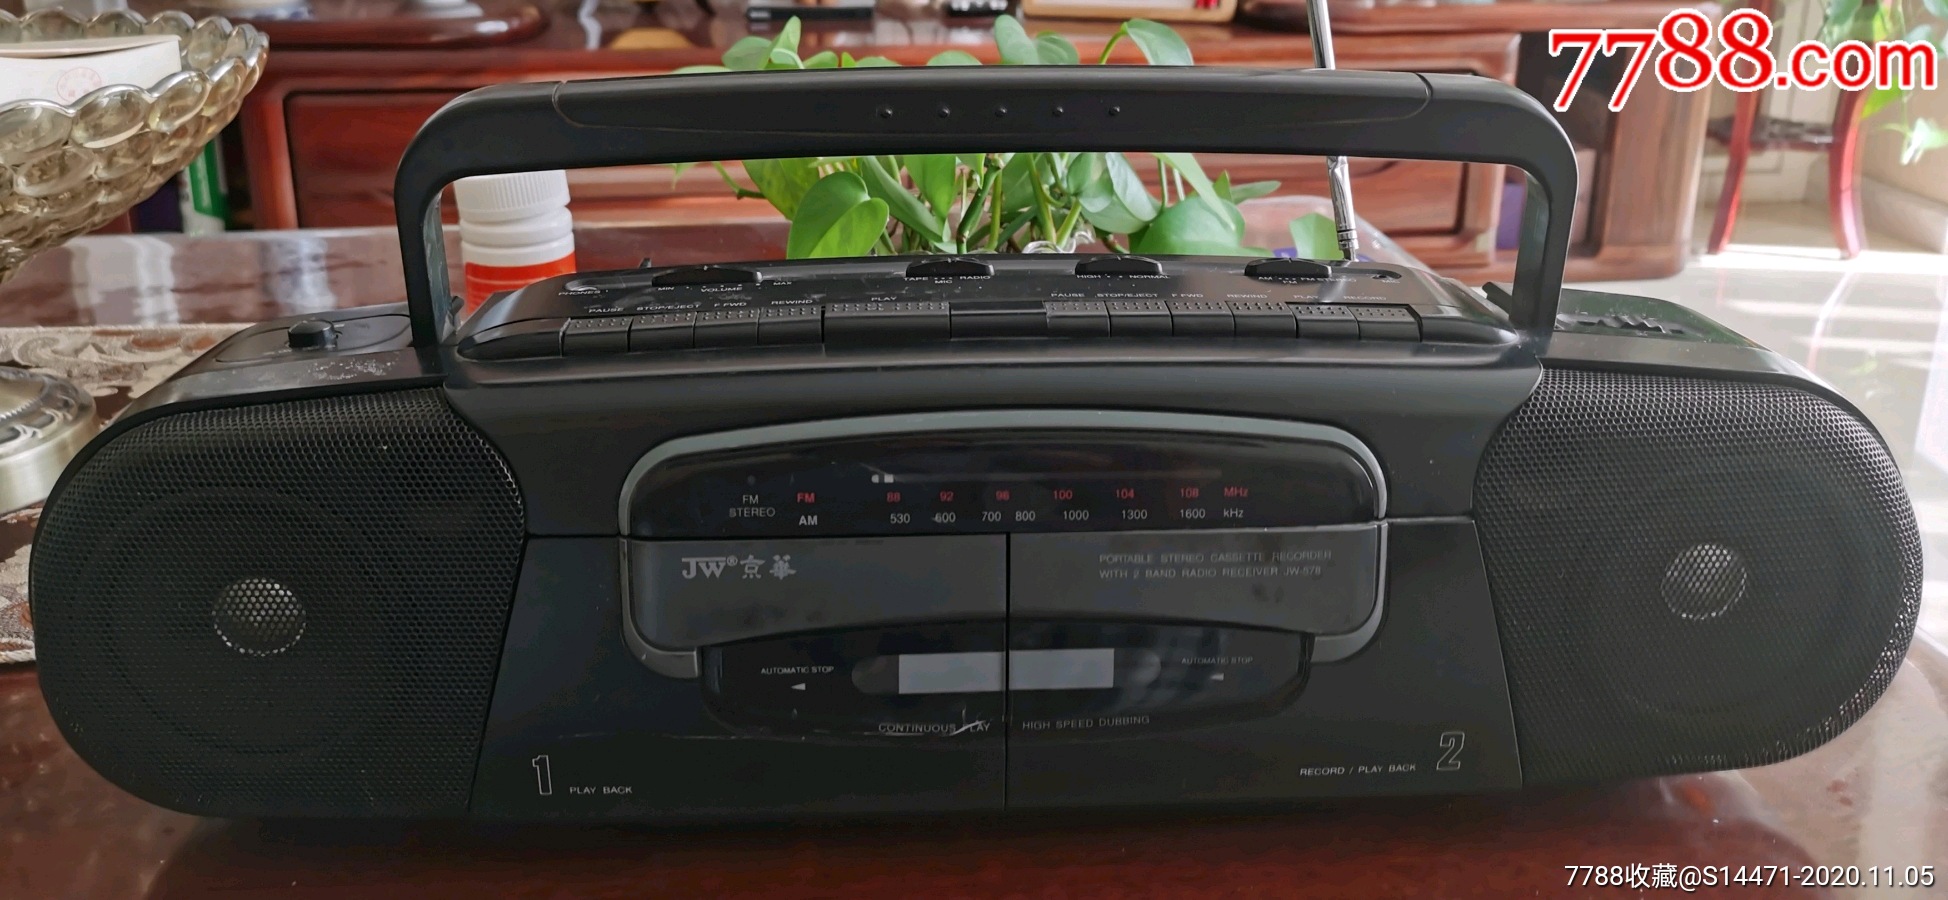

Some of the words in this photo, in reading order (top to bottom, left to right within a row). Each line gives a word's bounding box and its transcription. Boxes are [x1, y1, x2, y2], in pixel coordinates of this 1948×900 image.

[589, 306, 625, 314] PAUSE
[636, 303, 702, 312] STOP/EJECT
[742, 494, 759, 505] FM
[797, 492, 815, 503] FM
[886, 491, 901, 503] 88
[939, 491, 954, 502] 92
[1053, 489, 1073, 500] 100
[1115, 488, 1135, 499] 104
[1179, 487, 1199, 498] 108
[1224, 487, 1249, 498] MHz
[729, 507, 776, 518] STEREO
[799, 514, 818, 526] AM
[890, 513, 911, 524] 530
[935, 512, 956, 523] 600
[981, 511, 1002, 522] 700
[1015, 510, 1036, 522] 800
[1063, 509, 1090, 521] 1000
[1121, 509, 1147, 520] 1300
[1179, 508, 1206, 519] 1600
[1223, 507, 1244, 519] kHz
[1099, 553, 1152, 564] PORTABLE
[1160, 552, 1205, 564] STEREO
[1210, 551, 1264, 563] CASSETTE
[1271, 549, 1332, 562] RECORDER
[1099, 568, 1128, 579] WITH
[1133, 568, 1140, 580] 2
[1145, 568, 1177, 579] BAND
[1182, 567, 1217, 578] RADIO
[1222, 565, 1278, 578] RECEIVER
[1181, 656, 1229, 666] AUTOMATIC
[1230, 655, 1254, 665] STOP
[761, 665, 810, 675] AUTOMATIC
[811, 665, 835, 674] STOP
[878, 722, 957, 733] CONTINUOUS
[1022, 720, 1050, 731] HIGH
[1056, 718, 1094, 729] SPEED
[1099, 715, 1150, 727] DUBBING
[1436, 731, 1466, 771] 2
[532, 754, 553, 796] 1
[1300, 766, 1345, 777] RECORD
[1358, 765, 1384, 774] PLAY
[1388, 763, 1417, 773] BACK
[569, 786, 597, 795] PLAY
[602, 786, 633, 795] BACK
